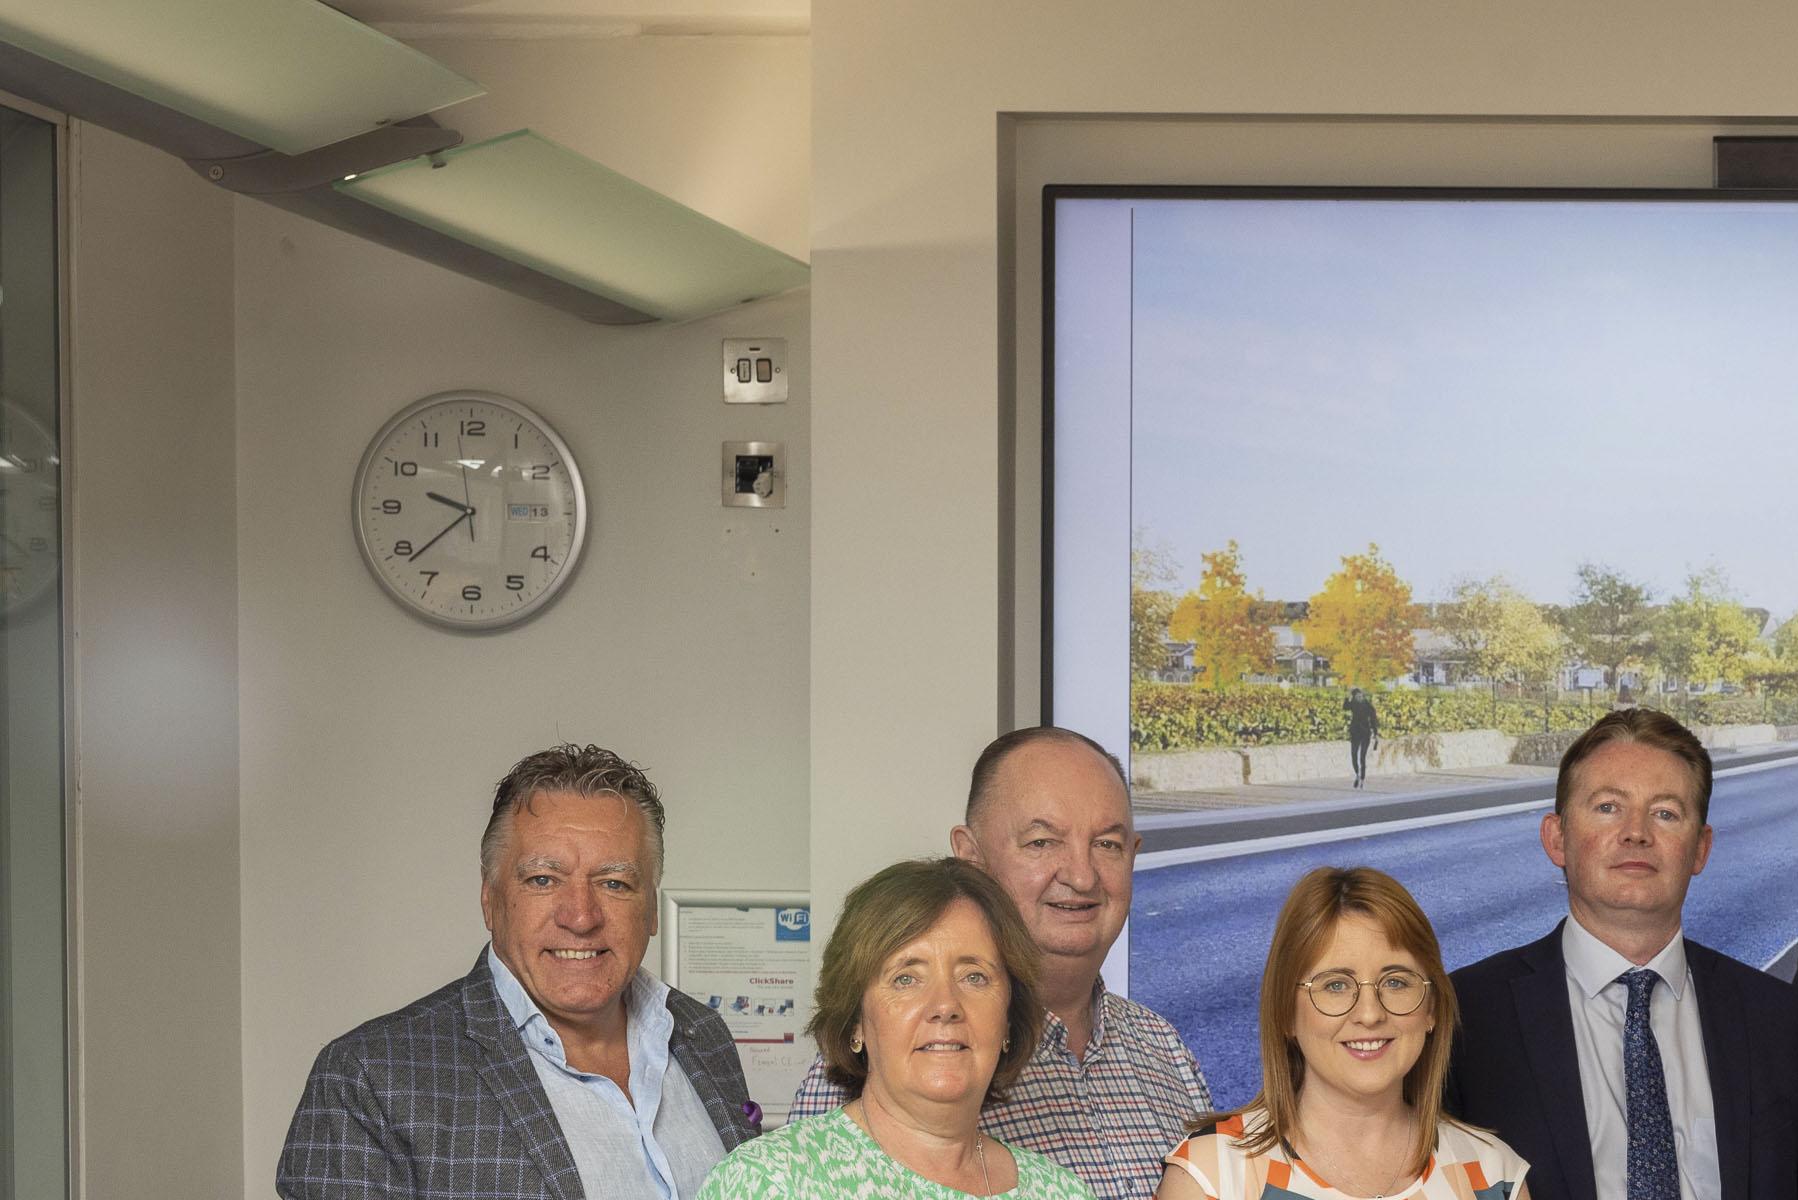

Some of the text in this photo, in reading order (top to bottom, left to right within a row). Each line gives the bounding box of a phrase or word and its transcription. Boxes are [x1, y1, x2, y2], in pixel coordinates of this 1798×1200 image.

[460, 420, 486, 437] 12
[424, 431, 439, 448] 11
[514, 433, 519, 449] 1
[394, 461, 418, 477] 10
[532, 465, 550, 480] 2
[382, 499, 402, 515] 9
[511, 505, 549, 518] WED 13
[394, 540, 413, 556] 8
[531, 546, 550, 562] 4
[419, 571, 439, 587] 7
[506, 575, 525, 590] 5
[462, 585, 482, 602] 6
[749, 977, 794, 985] ClickShare
